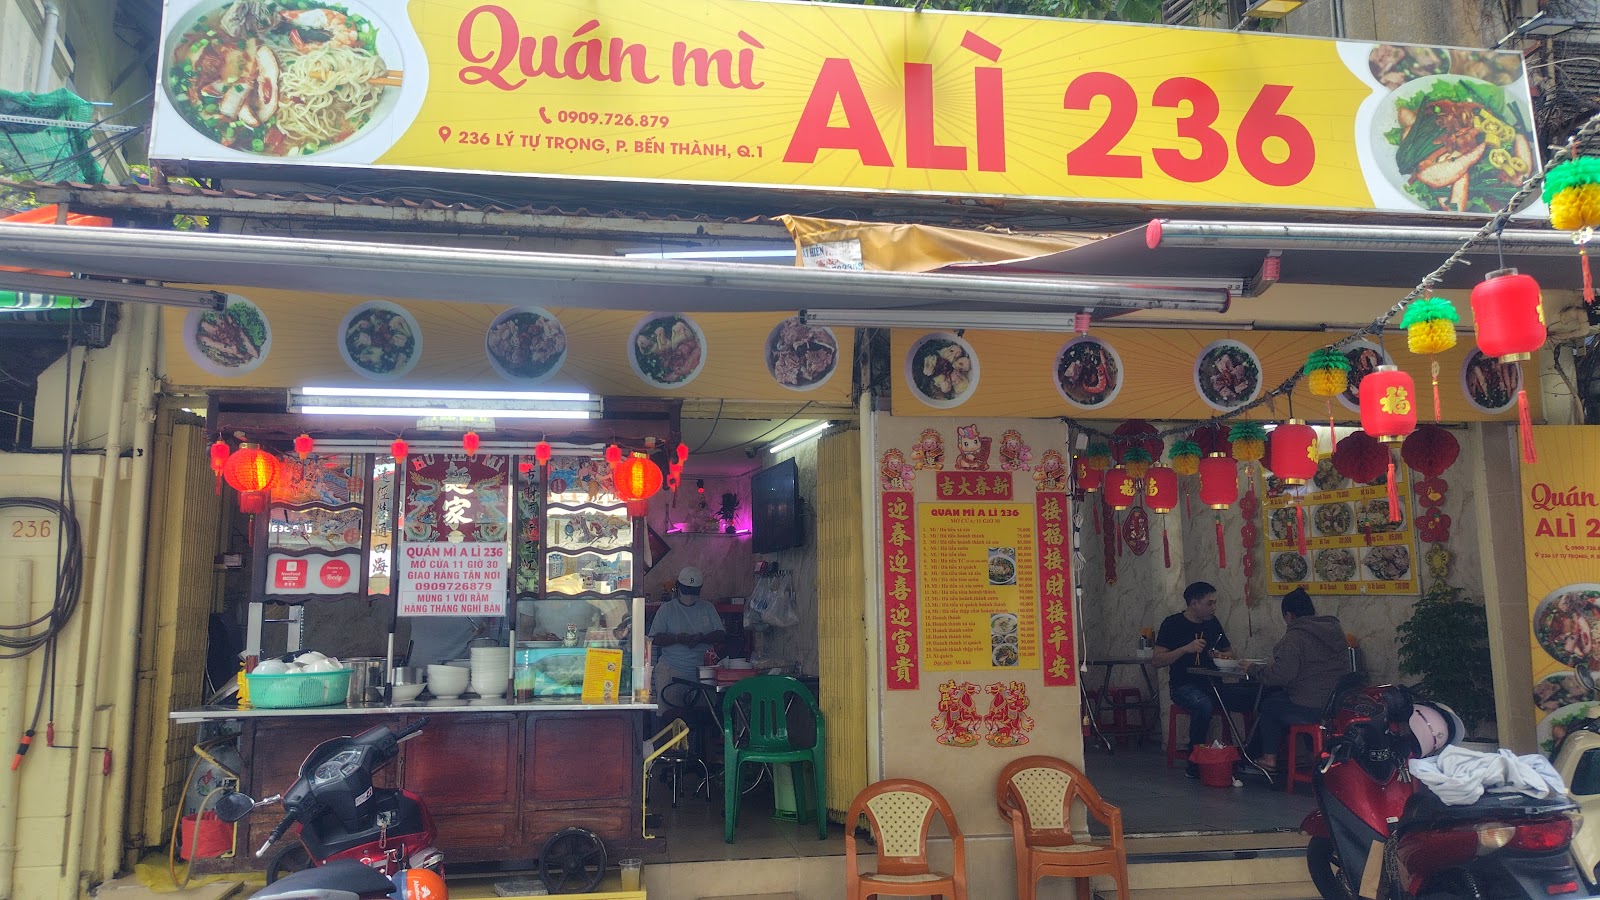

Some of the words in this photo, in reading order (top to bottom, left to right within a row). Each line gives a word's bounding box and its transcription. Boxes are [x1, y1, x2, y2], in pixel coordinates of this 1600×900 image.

[457, 4, 660, 91] Quán
[672, 30, 765, 90] mì
[782, 29, 1006, 172] ALÌ
[1063, 71, 1315, 187] 236
[557, 110, 670, 128] 0909.726.879
[459, 131, 491, 146] 236
[496, 130, 515, 147] LÝ
[520, 134, 541, 151] TỰ
[546, 136, 610, 154] TRỌNG,
[616, 139, 628, 152] P.
[634, 136, 665, 154] BẾN
[670, 138, 731, 159] THÀNH,
[737, 145, 763, 158] Q.1
[1380, 386, 1410, 415] 福
[1120, 479, 1135, 497] 福
[1531, 482, 1599, 511] Quán
[931, 507, 960, 517] QUÁN
[962, 507, 975, 517] MÌ
[977, 509, 986, 517] A
[988, 507, 998, 517] LÌ
[1000, 509, 1020, 517] 236
[12, 520, 51, 538] 236
[1535, 512, 1576, 537] ALÌ
[406, 545, 440, 558] QUÁN
[443, 545, 457, 557] MÌ
[460, 548, 468, 557] A
[471, 545, 481, 557] LÌ
[484, 547, 503, 557] 236
[410, 558, 426, 568] MỞ
[429, 558, 449, 568] CỬA
[453, 560, 463, 568] 11
[467, 558, 484, 568] GIỜ
[486, 560, 498, 568] 30
[407, 571, 431, 579] GIAO
[433, 569, 460, 579] HÀNG
[415, 582, 492, 591] 0909726879
[445, 594, 450, 602] 1
[404, 603, 427, 612] HÀNG
[430, 603, 458, 612] THÁNG
[483, 603, 501, 612] BÁN
